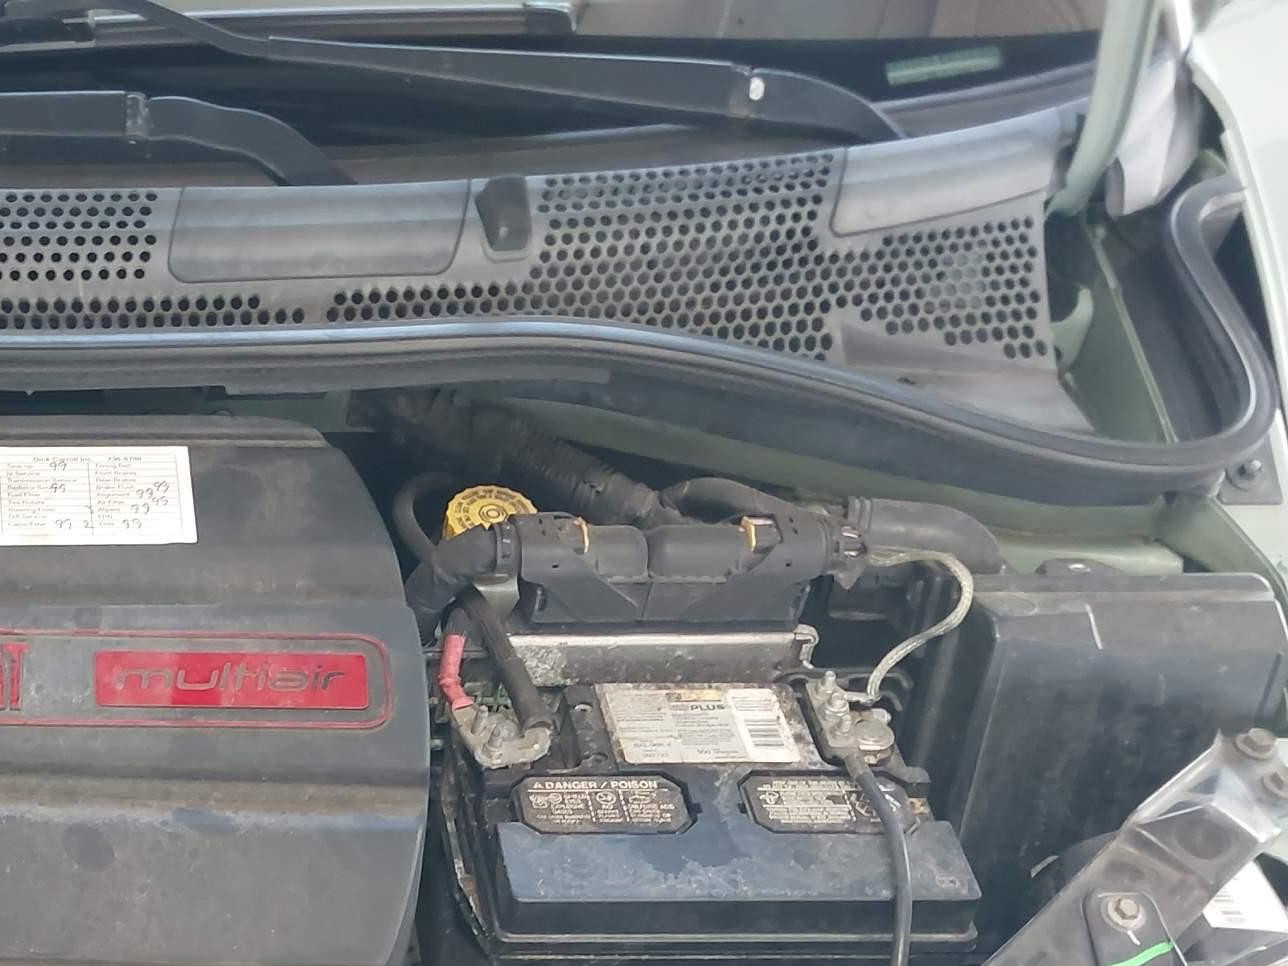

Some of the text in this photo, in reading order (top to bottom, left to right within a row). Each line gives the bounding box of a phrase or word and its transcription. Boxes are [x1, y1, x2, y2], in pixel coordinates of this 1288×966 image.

[113, 661, 345, 694] multiair
[544, 781, 598, 790] DANGER
[610, 780, 658, 789] POISON
